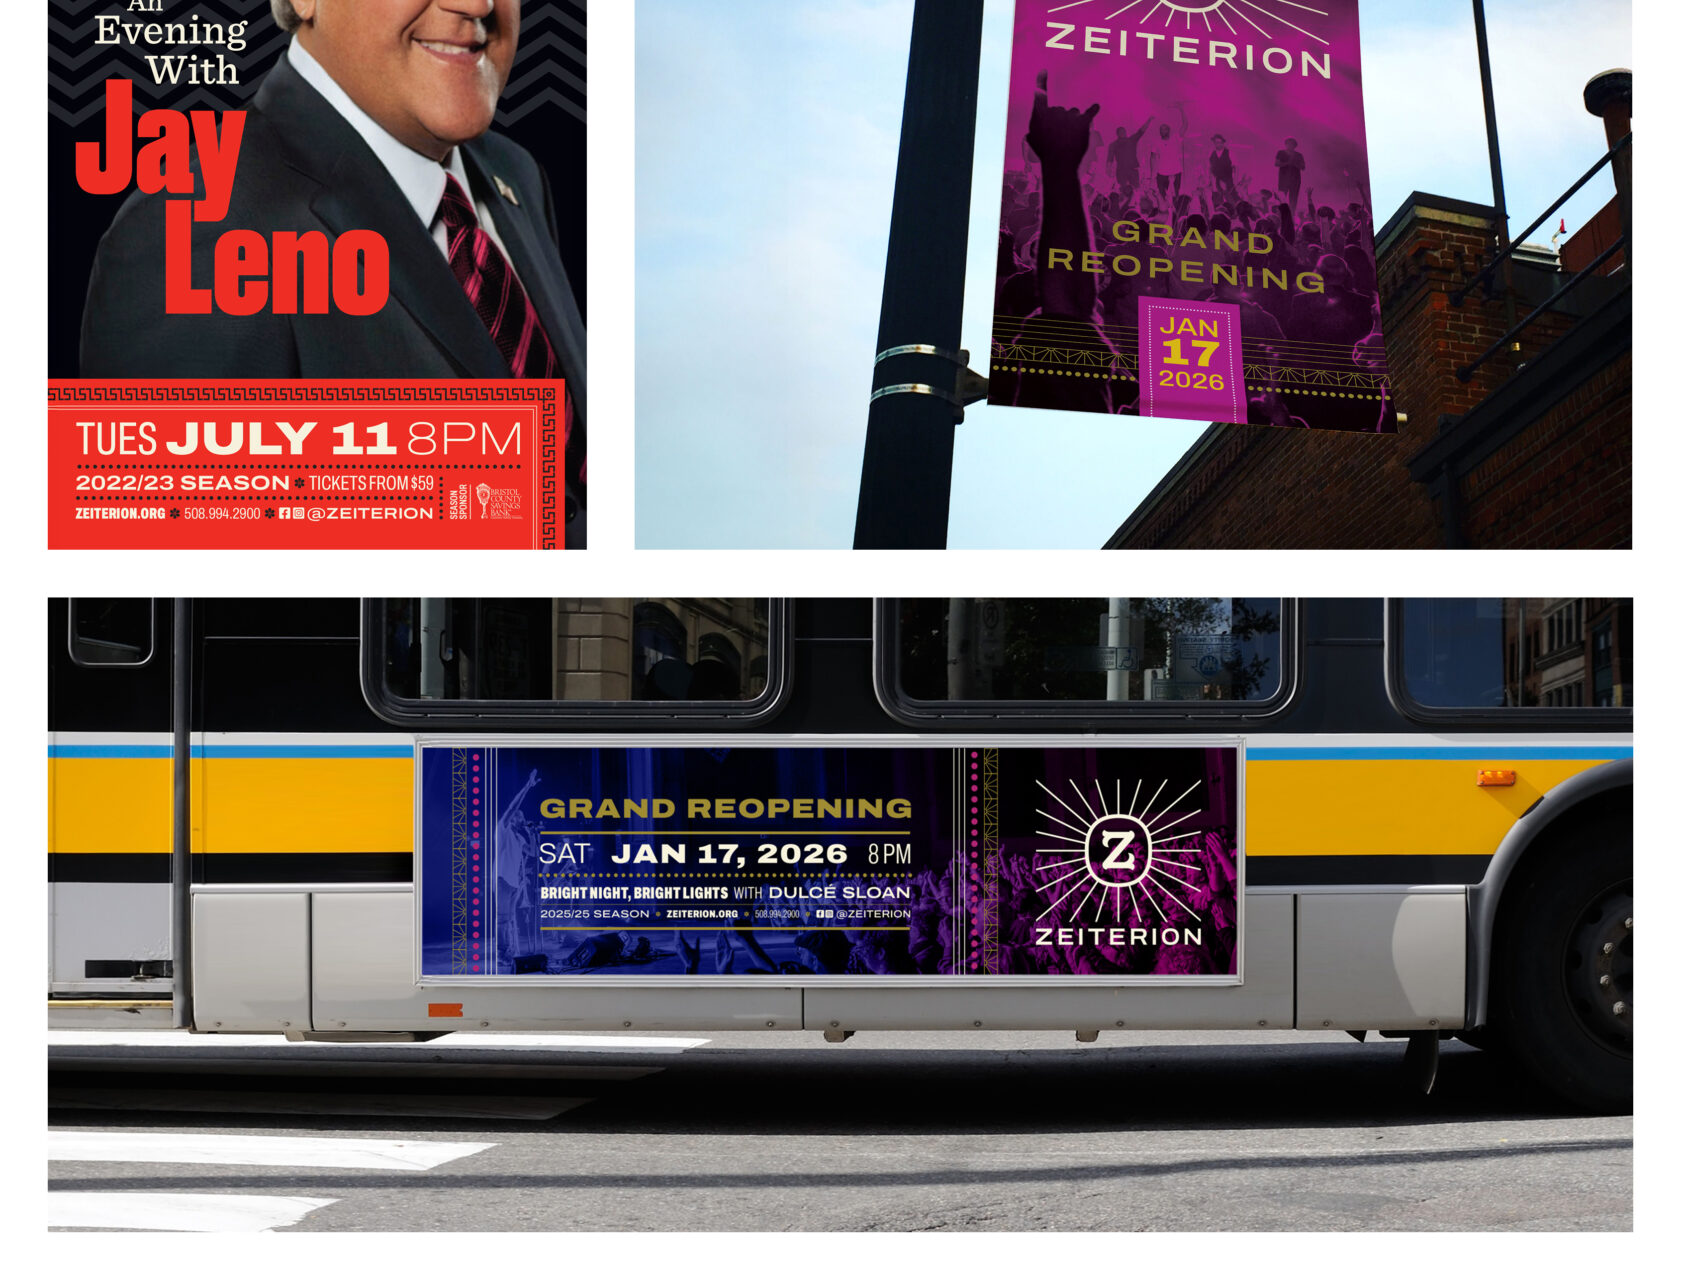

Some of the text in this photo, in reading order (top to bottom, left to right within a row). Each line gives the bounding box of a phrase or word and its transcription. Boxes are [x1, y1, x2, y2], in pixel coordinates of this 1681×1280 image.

[95, 15, 248, 51] Evening
[1045, 21, 1331, 79] ZEITERION
[144, 55, 239, 85] With
[75, 79, 247, 222] Jay
[1113, 220, 1274, 254] GRAND
[166, 200, 389, 316] Leno
[1047, 248, 1325, 293] REOPENING
[1159, 317, 1218, 338] JAN
[1162, 338, 1220, 367] 17
[1159, 370, 1224, 391] 2026
[76, 422, 520, 455] TUES JULY 11 8PM
[76, 475, 434, 491] 2022/23 SEASON TICKETS FROM $59
[76, 507, 433, 521] ZEITERION.ORG 508.994.2900 @ZEITERION
[450, 490, 458, 519] SEASON
[459, 484, 467, 519] SPONSOR
[540, 799, 911, 818] GRAND REOPENING
[539, 843, 911, 869] SAT JAN 17, 2026 8 PM
[1102, 830, 1135, 870] Z
[541, 883, 910, 902] BRIGHT NIGHT, BRIGHT LIGHTS WITH DULCÉ SLOAN
[541, 910, 590, 918] 2025/25
[594, 910, 649, 918] SEASON
[667, 910, 738, 918] ZEITERION.ORG
[837, 910, 911, 919] @ZEITERION
[1036, 928, 1202, 946] ZEITERION
